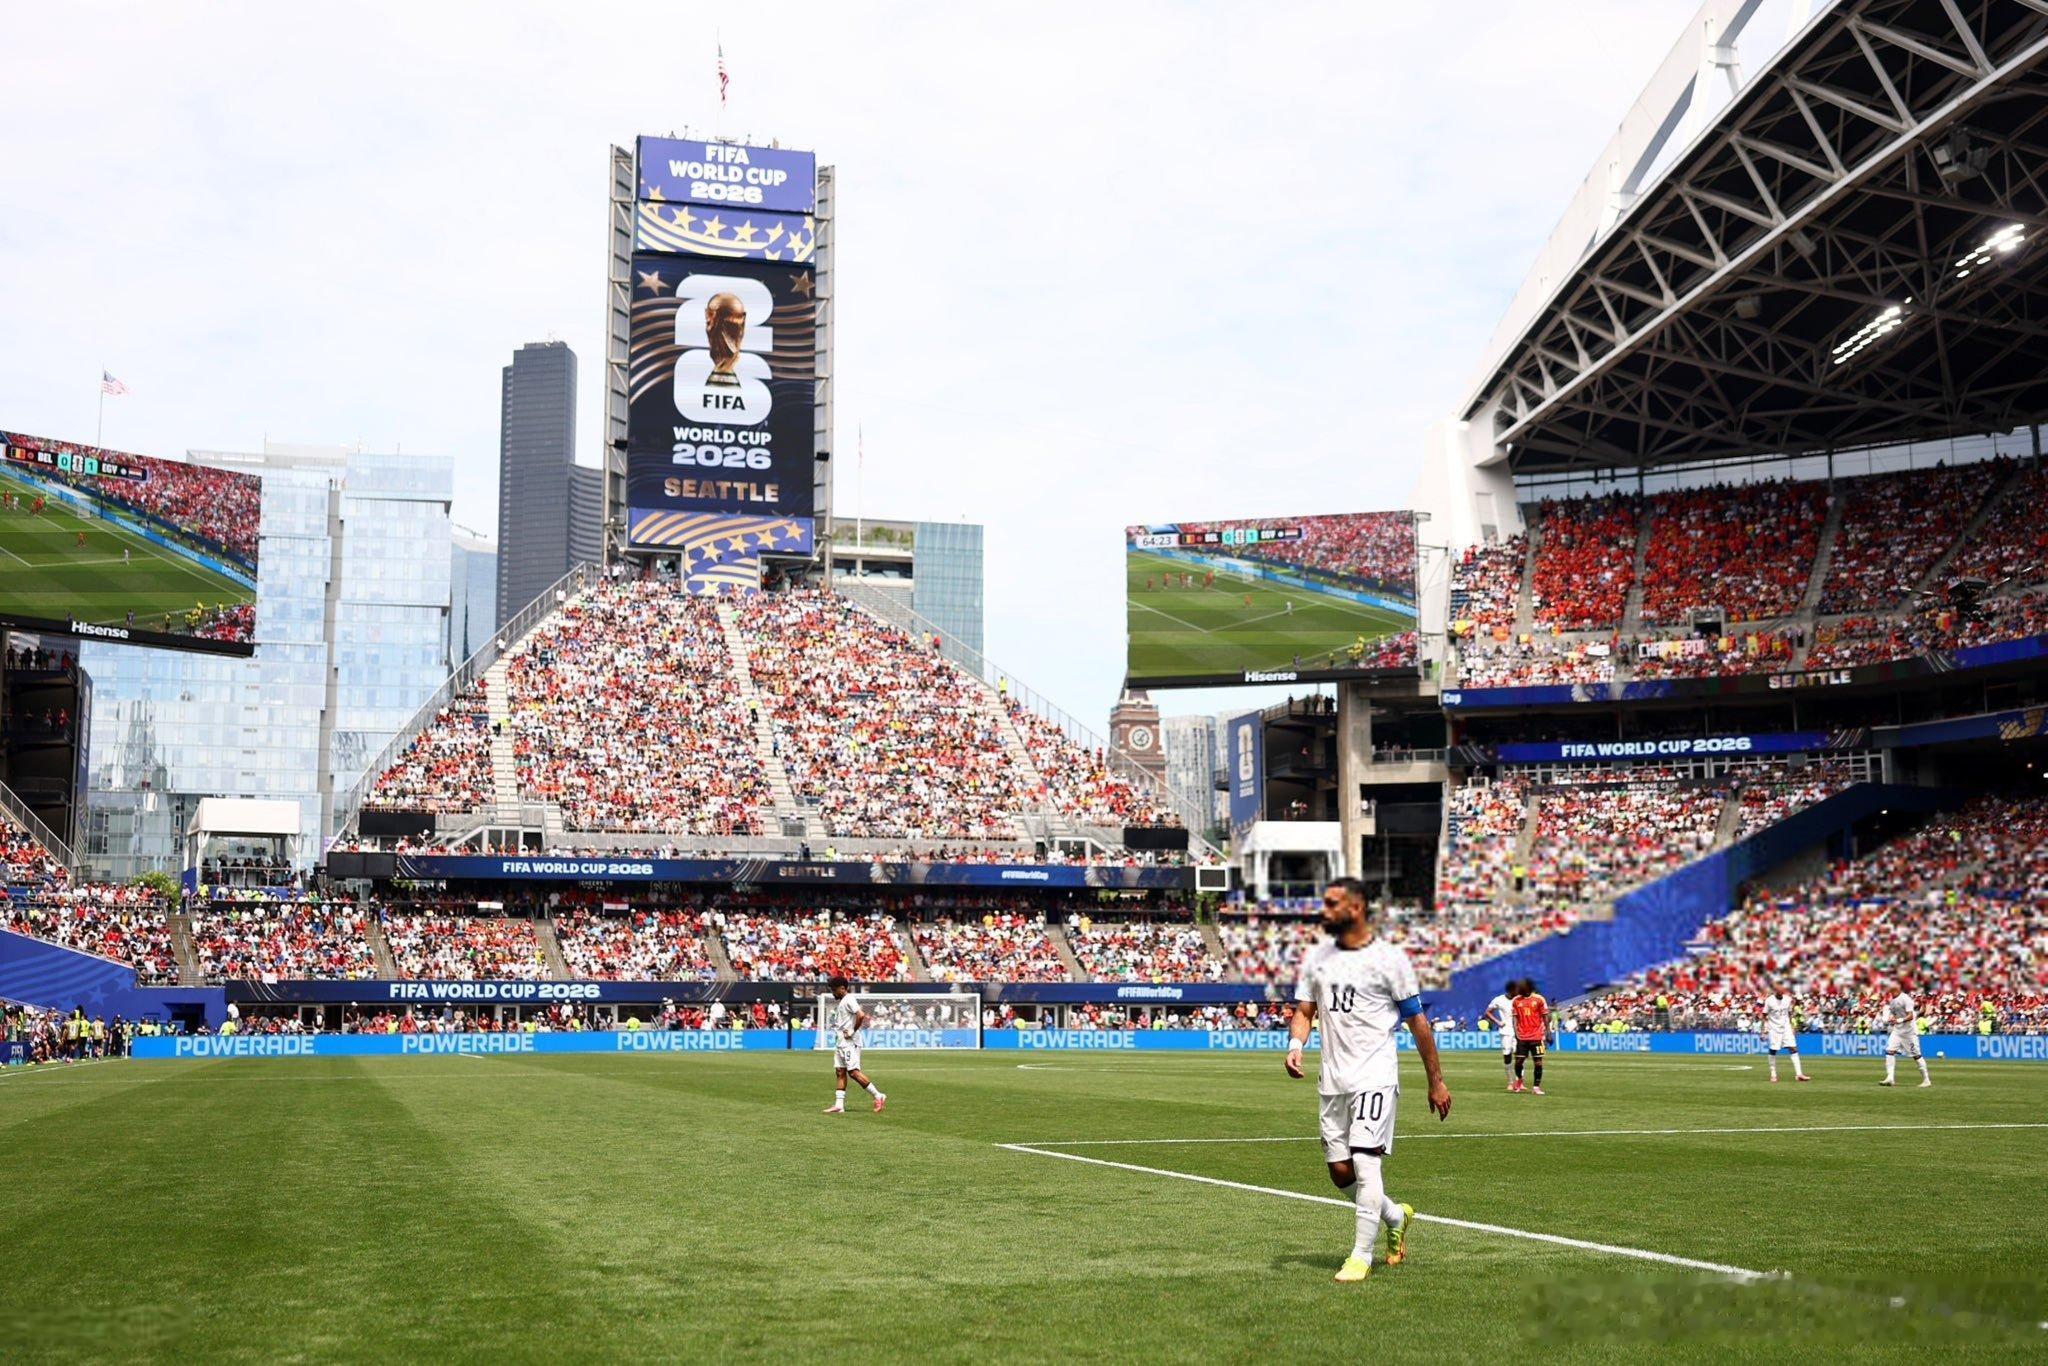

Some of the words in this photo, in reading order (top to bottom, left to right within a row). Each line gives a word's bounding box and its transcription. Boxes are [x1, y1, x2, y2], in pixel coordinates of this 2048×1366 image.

[705, 145, 750, 165] FIFA
[668, 159, 744, 183] WORLD
[746, 168, 787, 187] CUP
[690, 181, 763, 204] 2026
[702, 393, 746, 411] FIFA
[672, 426, 735, 444] WORLD
[738, 430, 772, 446] CUP
[61, 456, 68, 466] 0
[672, 443, 772, 470] 2026
[664, 477, 780, 503] SEATTLE
[1142, 535, 1172, 547] 64:23
[71, 620, 130, 639] Hisense
[1244, 671, 1298, 682] Hisense
[1768, 670, 1852, 690] SEATTLE
[1561, 744, 1595, 758] FIFA
[1597, 741, 1656, 756] WORLD
[1658, 740, 1692, 754] CUP
[1693, 737, 1752, 752] 2026
[502, 862, 531, 873] FIFA
[532, 862, 579, 874] WORLD
[581, 863, 607, 874] CUP
[608, 863, 654, 875] 2026
[779, 866, 836, 878] SEATTLE
[389, 983, 429, 998] FIFA
[431, 983, 497, 998] WORLD
[499, 984, 536, 998] CUP
[538, 984, 600, 998] 2026
[1117, 986, 1183, 999] #FIFAWorldCup
[1329, 984, 1355, 1013] 10
[175, 1035, 315, 1057] POWERADE
[402, 1034, 535, 1053] POWERADE
[617, 1031, 744, 1050] POWERADE
[1018, 1031, 1135, 1048] POWERADE
[1576, 1033, 1651, 1051] POWERADE
[1695, 1033, 1769, 1052] POWERADE
[1356, 1091, 1384, 1121] 10
